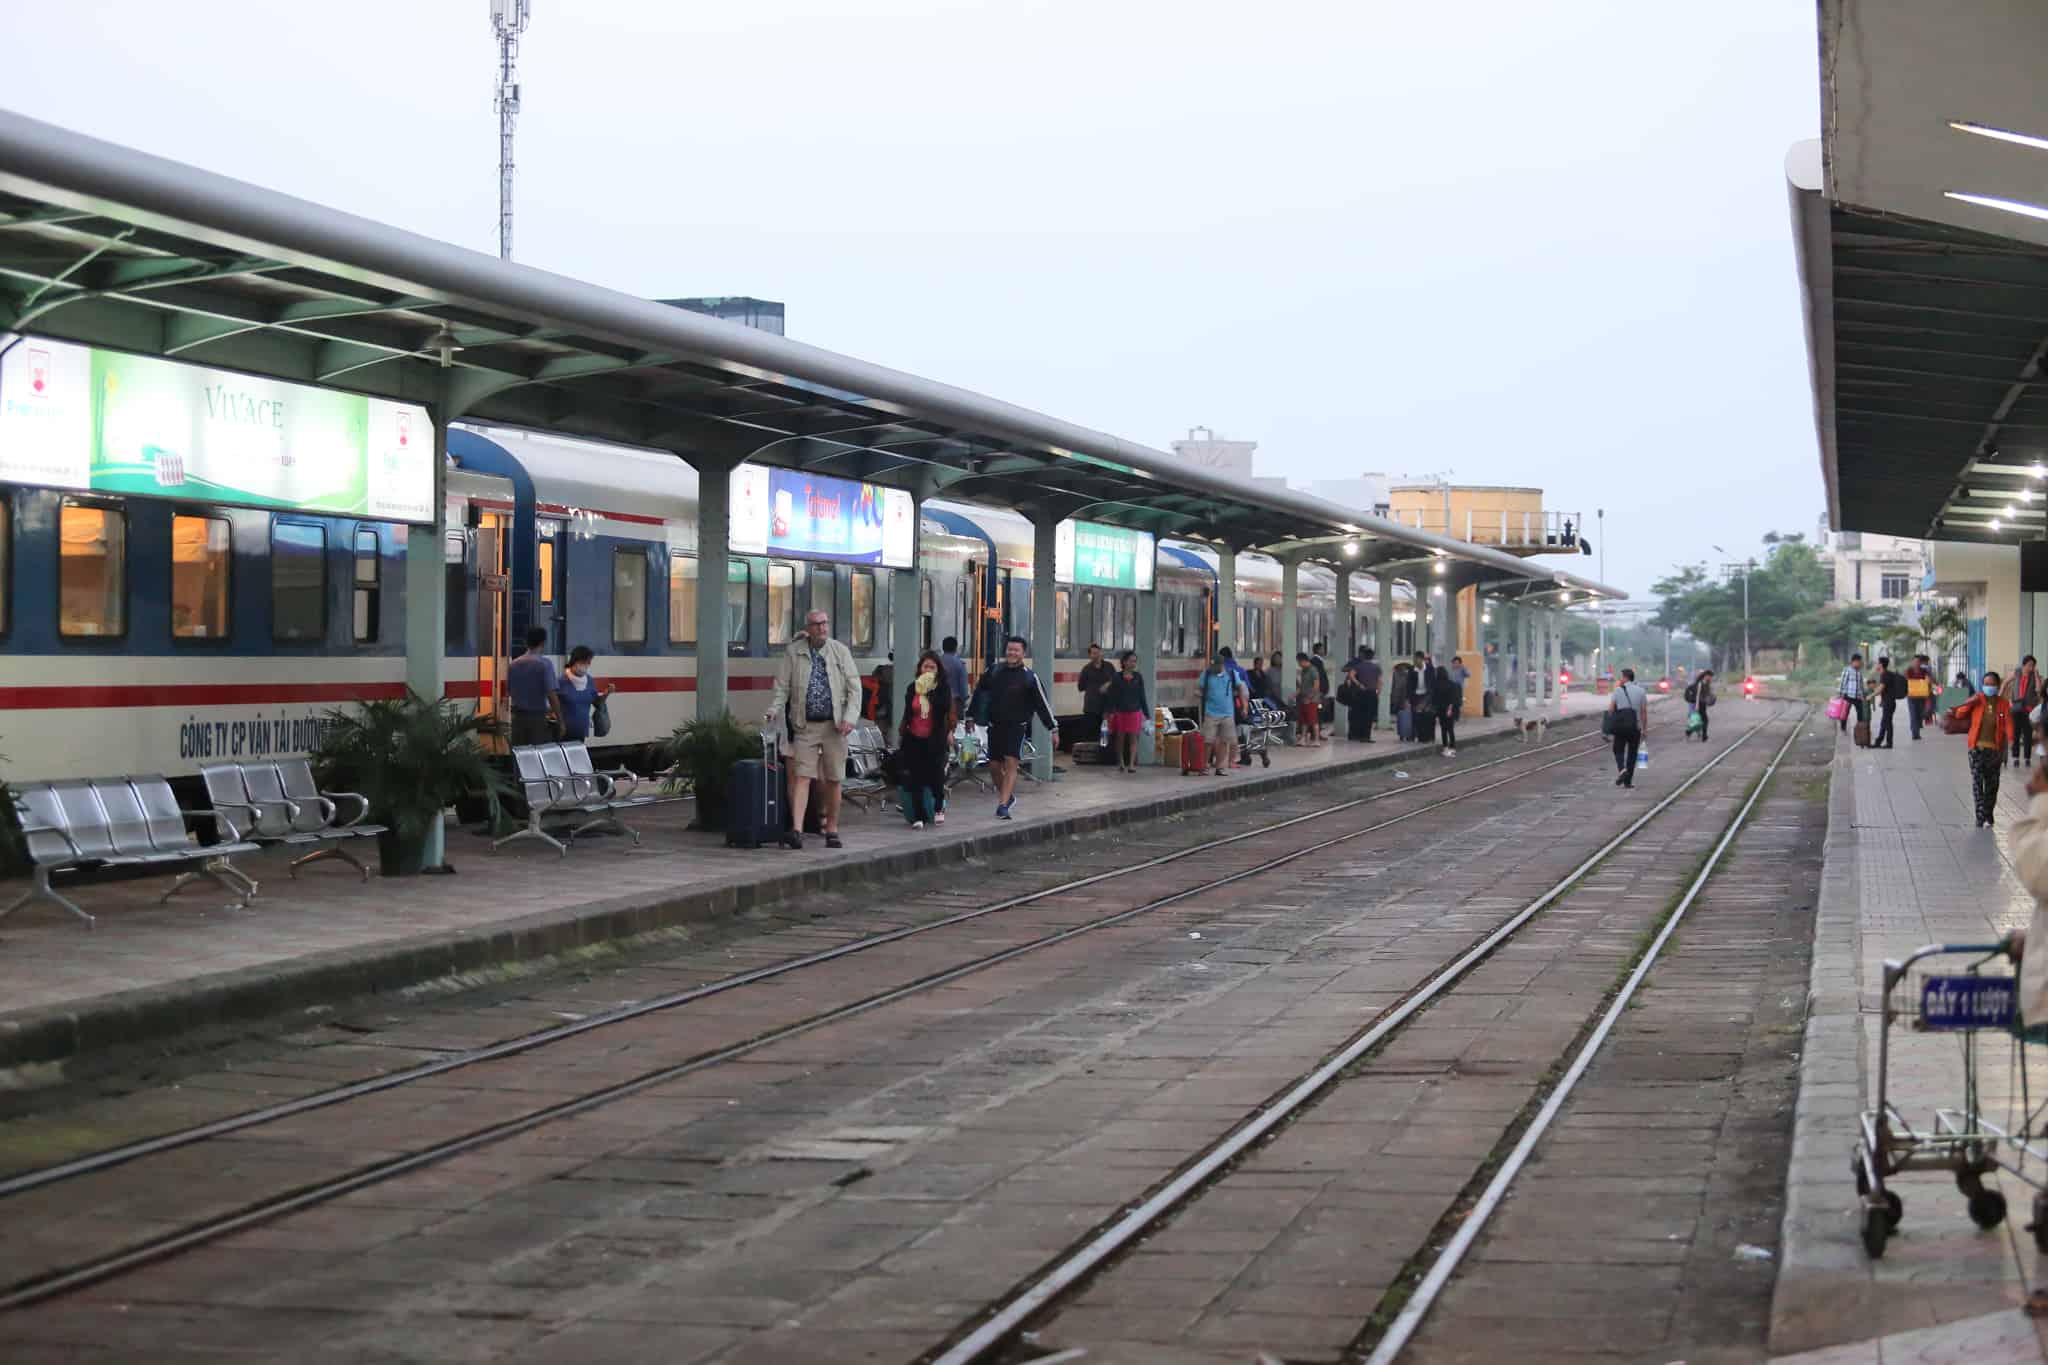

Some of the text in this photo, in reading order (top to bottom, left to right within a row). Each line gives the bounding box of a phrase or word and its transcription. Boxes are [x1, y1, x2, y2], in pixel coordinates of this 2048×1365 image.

[203, 383, 285, 429] VIVACE
[180, 714, 212, 759] CÔNG
[215, 721, 229, 757] TY
[231, 720, 246, 756] CP
[248, 711, 271, 760] VẬN
[1960, 991, 1968, 1016] 1
